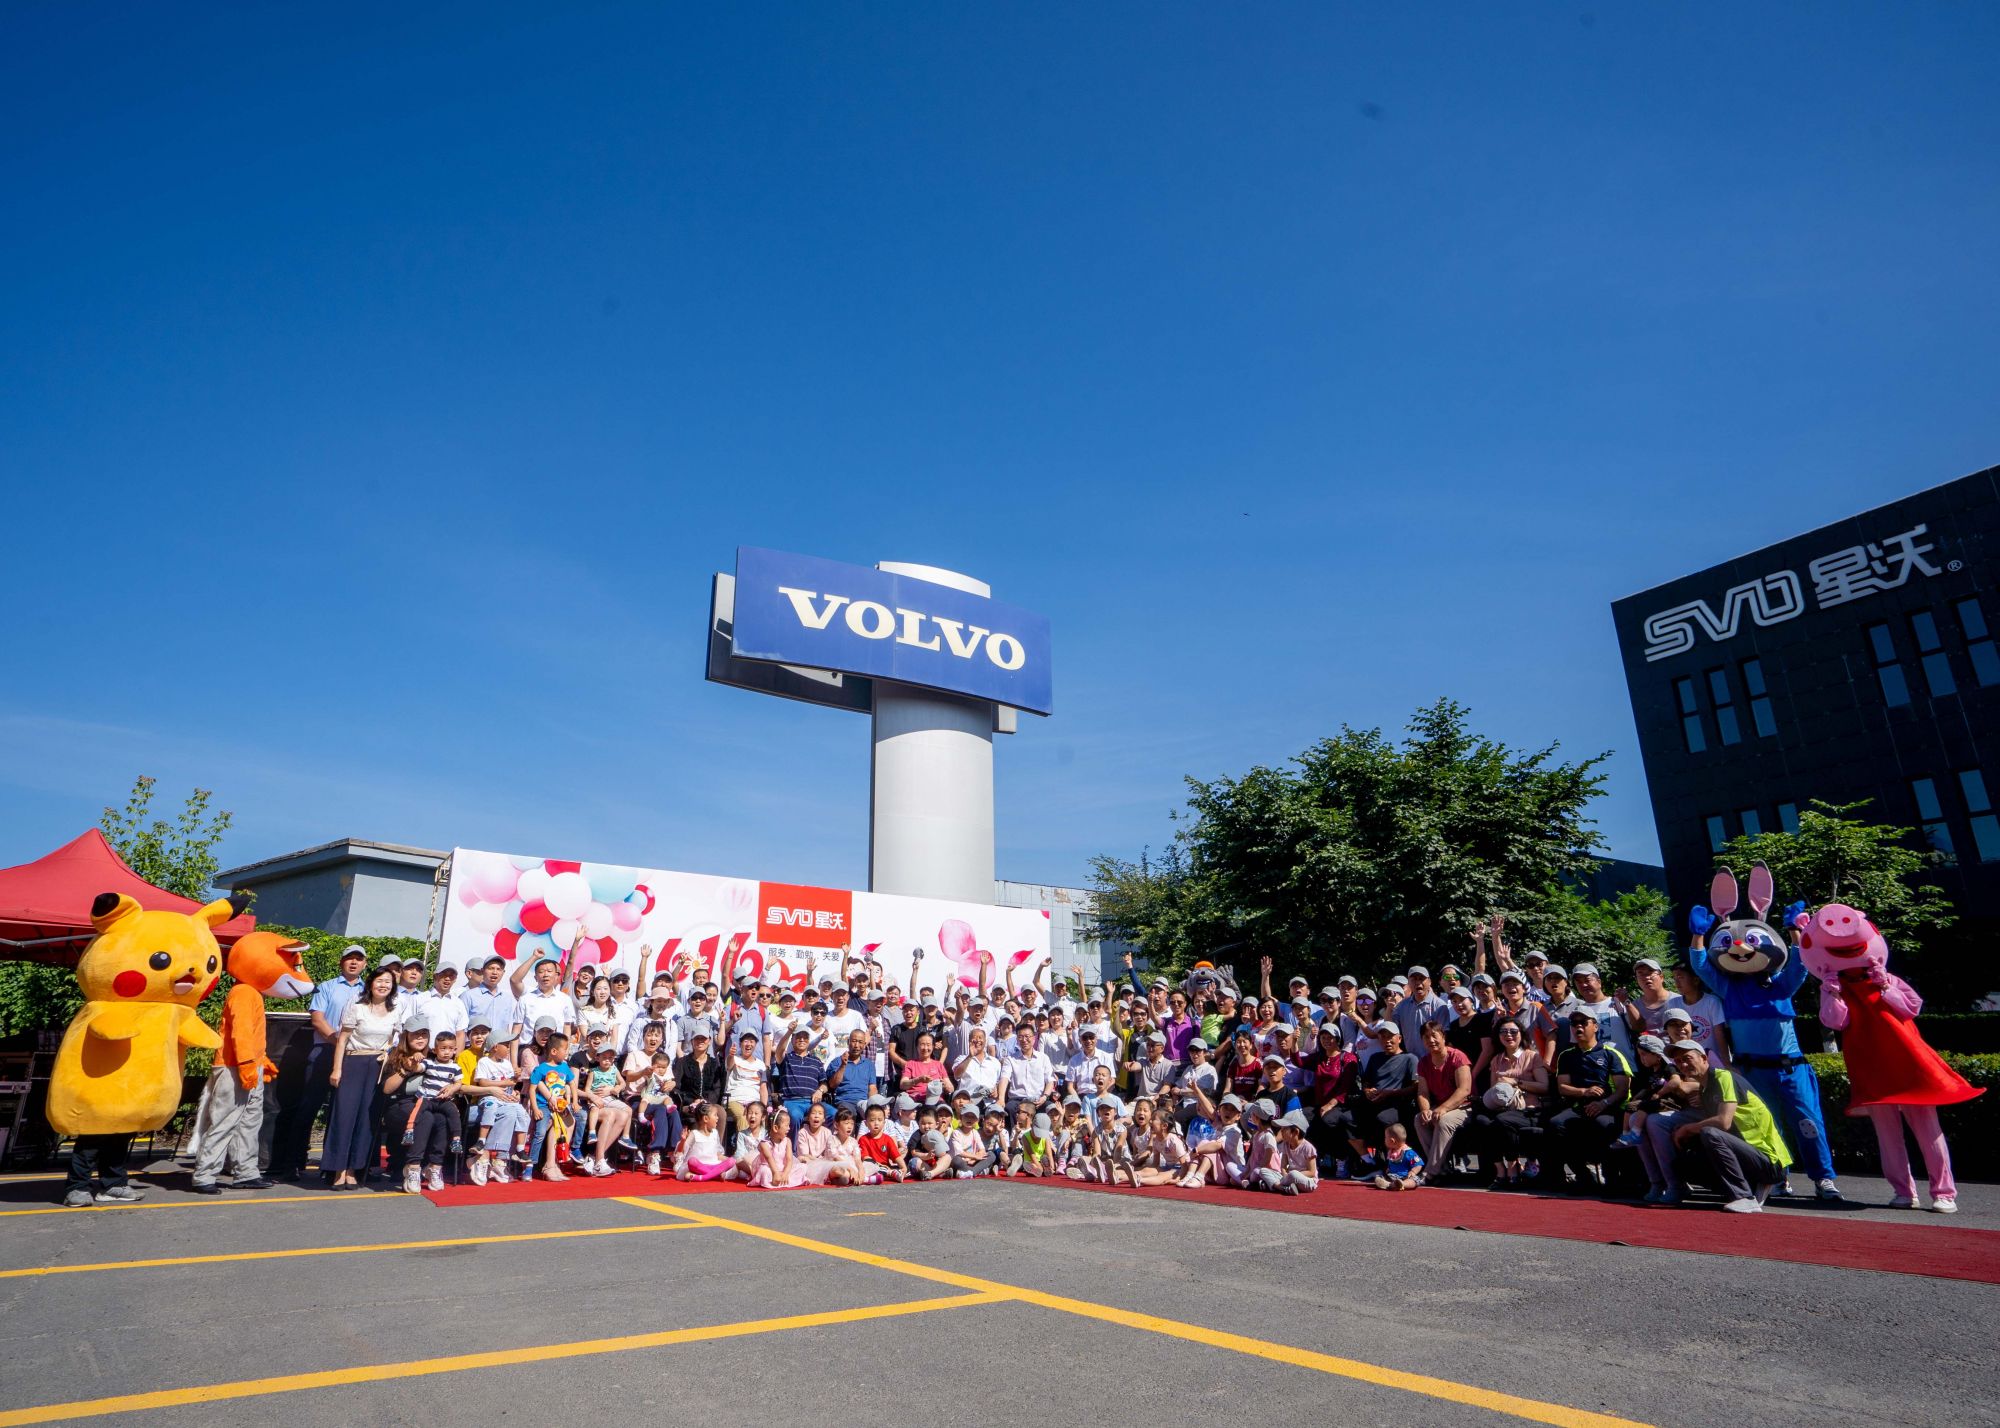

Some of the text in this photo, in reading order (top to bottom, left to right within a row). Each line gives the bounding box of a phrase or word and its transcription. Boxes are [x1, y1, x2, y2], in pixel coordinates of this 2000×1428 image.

[1809, 523, 1942, 609] 星沃
[778, 587, 1026, 671] VOLVO
[815, 910, 844, 930] 星沃
